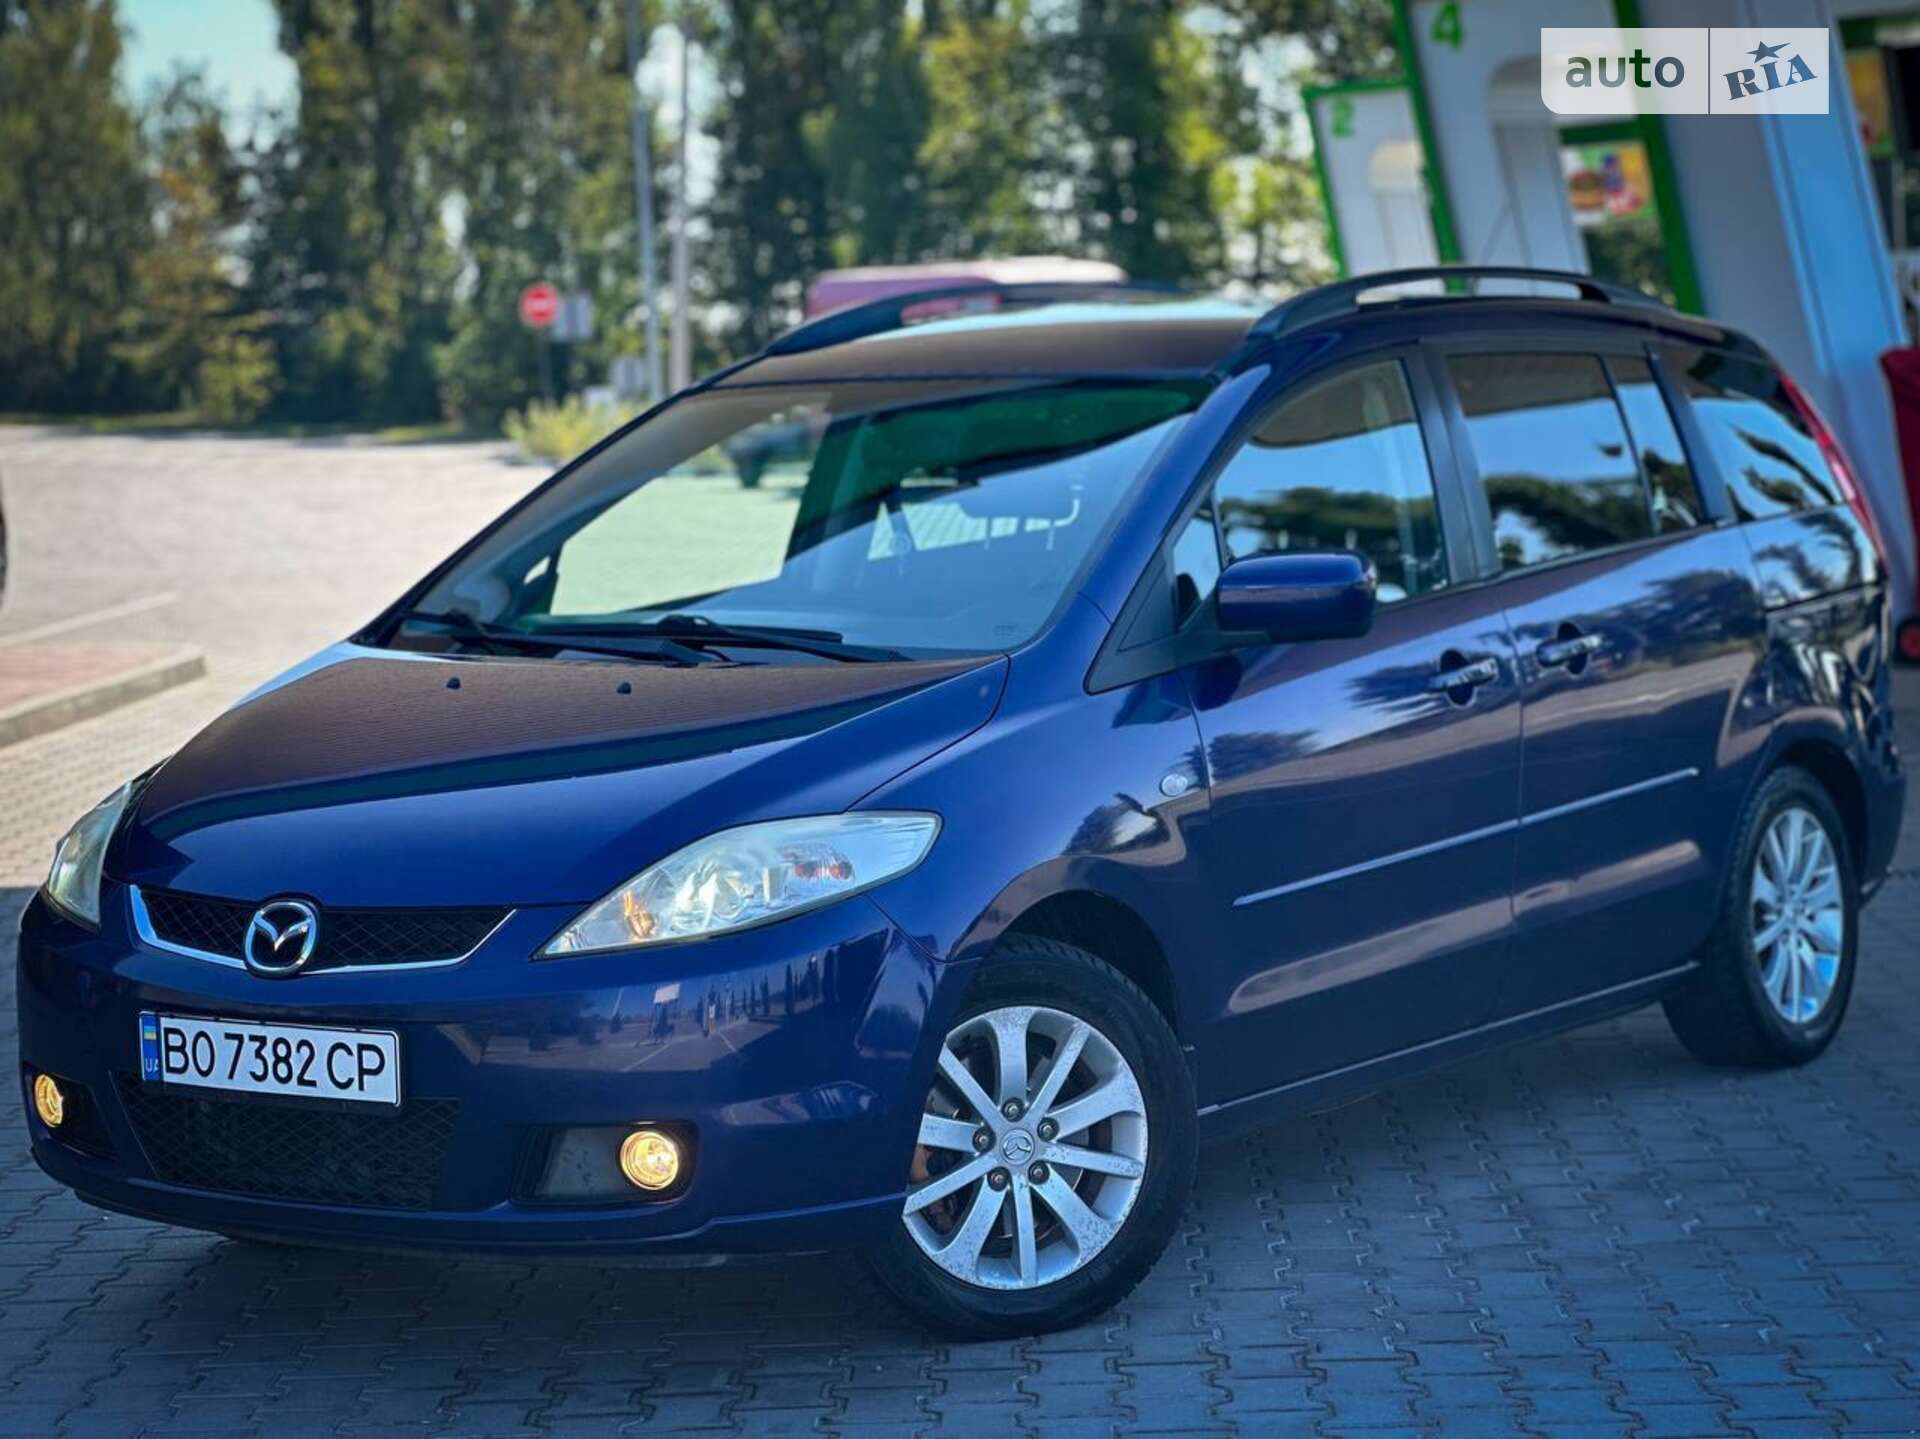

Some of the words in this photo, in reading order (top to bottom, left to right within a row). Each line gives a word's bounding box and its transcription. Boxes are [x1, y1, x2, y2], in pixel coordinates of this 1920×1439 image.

[1431, 2, 1464, 48] 4
[163, 1027, 216, 1078] BO
[224, 1032, 318, 1088] 7382
[326, 1042, 386, 1092] CP
